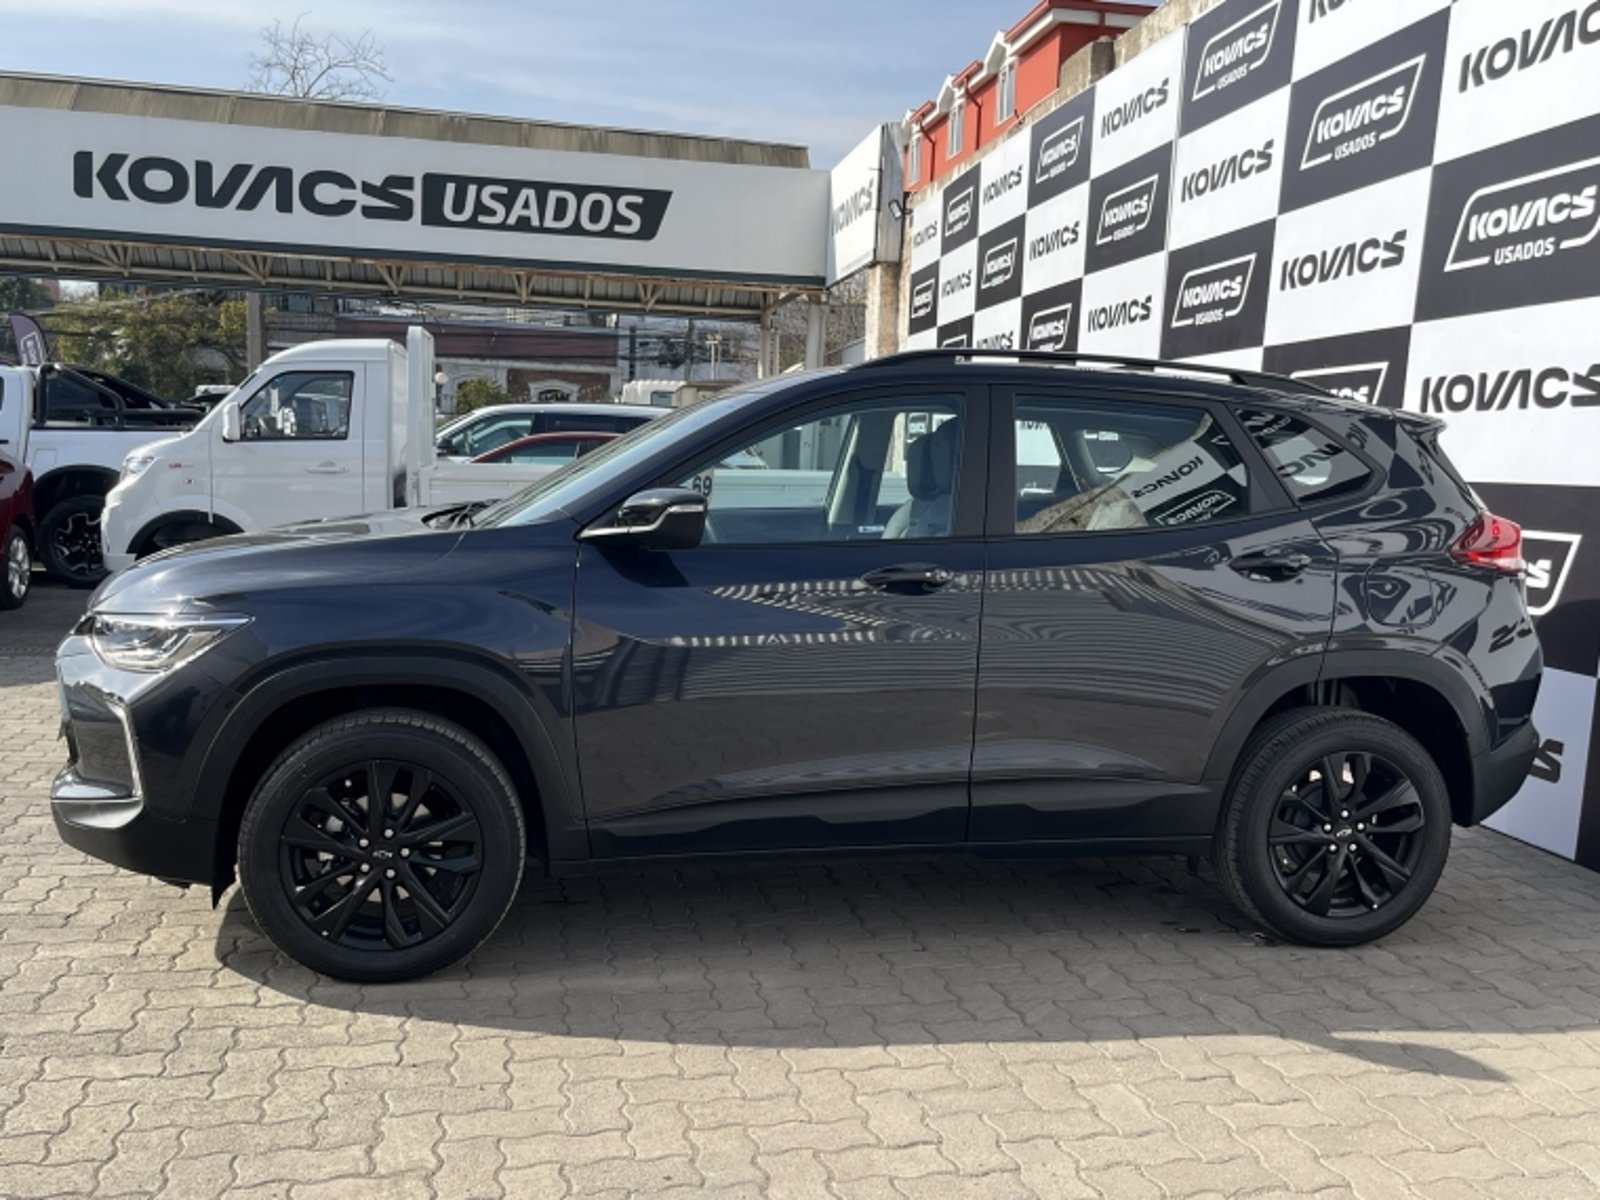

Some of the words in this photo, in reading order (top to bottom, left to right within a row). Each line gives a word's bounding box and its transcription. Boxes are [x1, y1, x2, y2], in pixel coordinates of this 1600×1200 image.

[1204, 23, 1269, 77] KOVACS
[1216, 64, 1248, 90] USADOS
[1101, 77, 1169, 138] KOVACS
[1317, 86, 1405, 143] KOVACS
[1042, 134, 1077, 167] KOVACS
[1335, 132, 1377, 160] USADOS
[982, 164, 1023, 205] KOVACS
[1181, 139, 1275, 203] KOVACS
[73, 150, 415, 221] KOVACS
[442, 182, 644, 235] USADOS
[1105, 194, 1149, 227] KOVACS
[1468, 185, 1598, 243] KOVACS
[1029, 221, 1080, 261] KOVACS
[1280, 229, 1407, 292] KOVACS
[1494, 237, 1556, 266] USADOS
[941, 269, 972, 298] KOVACS
[1183, 275, 1243, 308] KOVACS
[1031, 318, 1064, 341] KOVACS
[1087, 294, 1152, 332] KOVACS
[1195, 308, 1224, 326] USADOS
[1420, 363, 1600, 413] KOVACS
